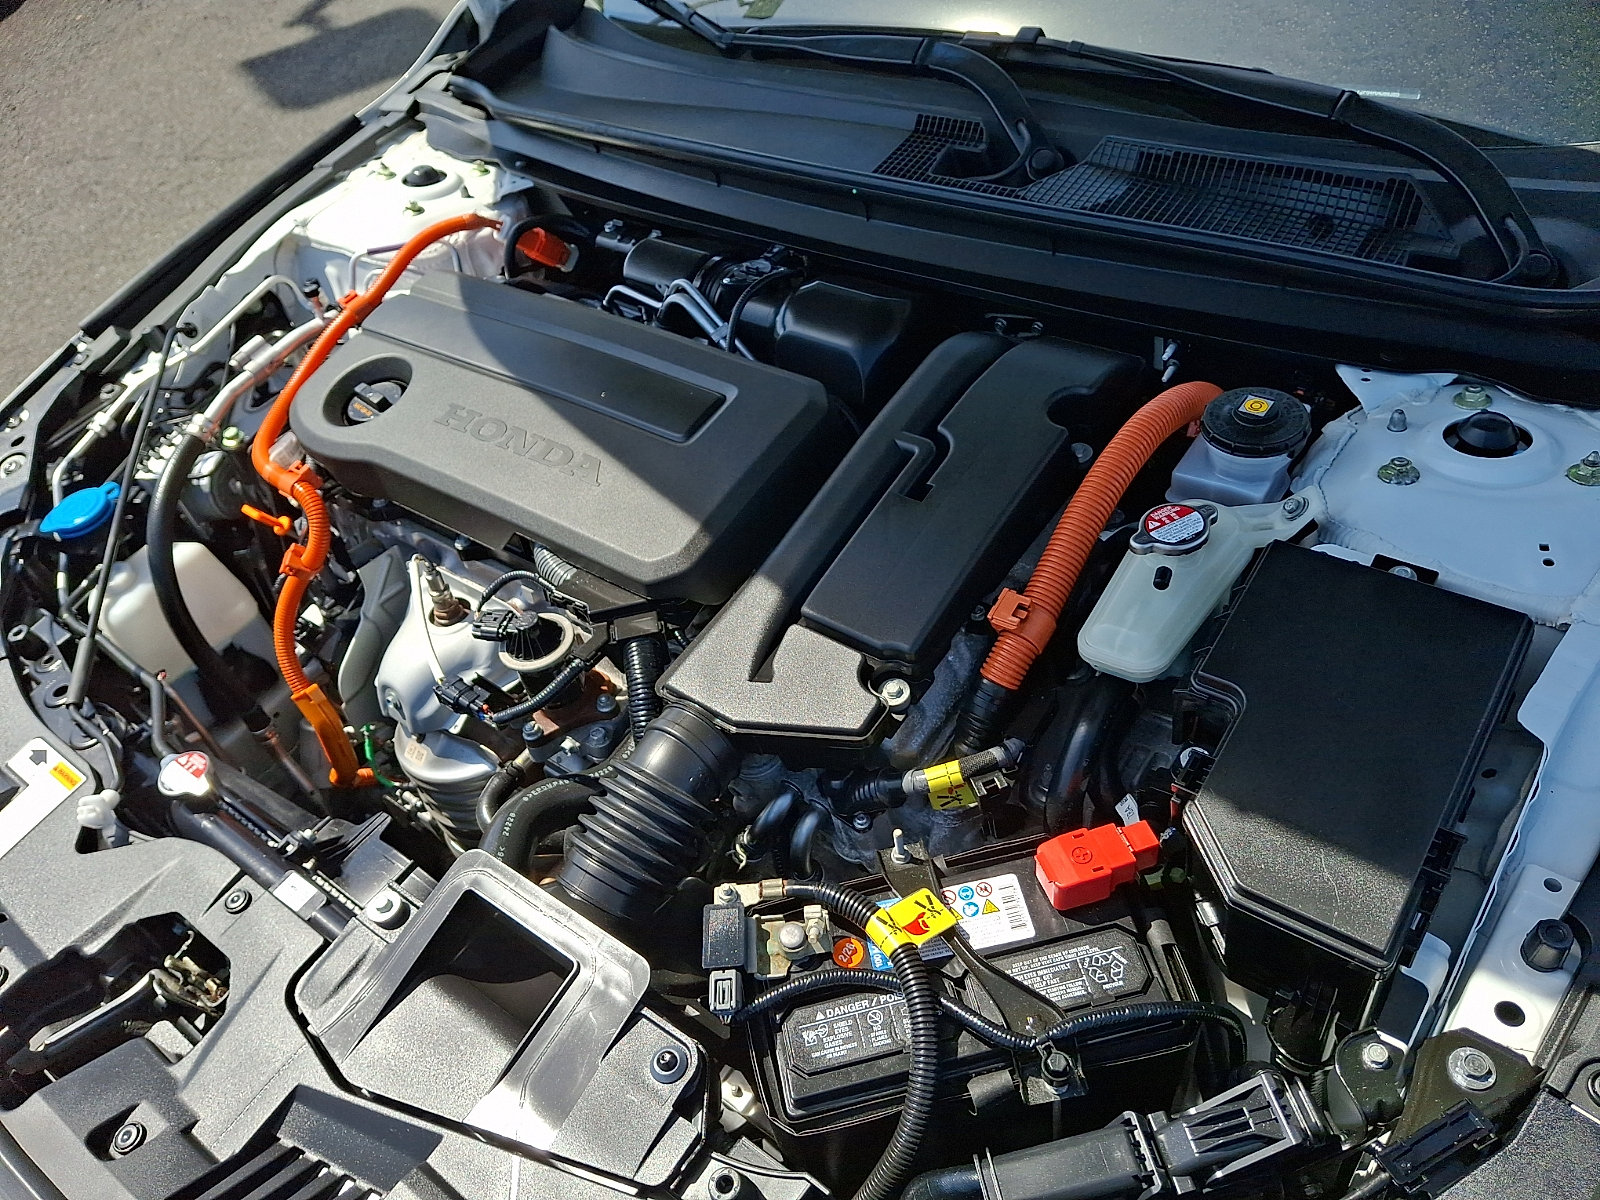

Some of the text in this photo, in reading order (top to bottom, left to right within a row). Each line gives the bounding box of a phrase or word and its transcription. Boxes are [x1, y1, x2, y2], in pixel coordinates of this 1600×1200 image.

[434, 403, 601, 487] HONDA
[838, 942, 855, 963] 2/26
[825, 999, 869, 1017] DANGER
[823, 1031, 853, 1042] EXPLOSIVE
[834, 1026, 849, 1034] EYES
